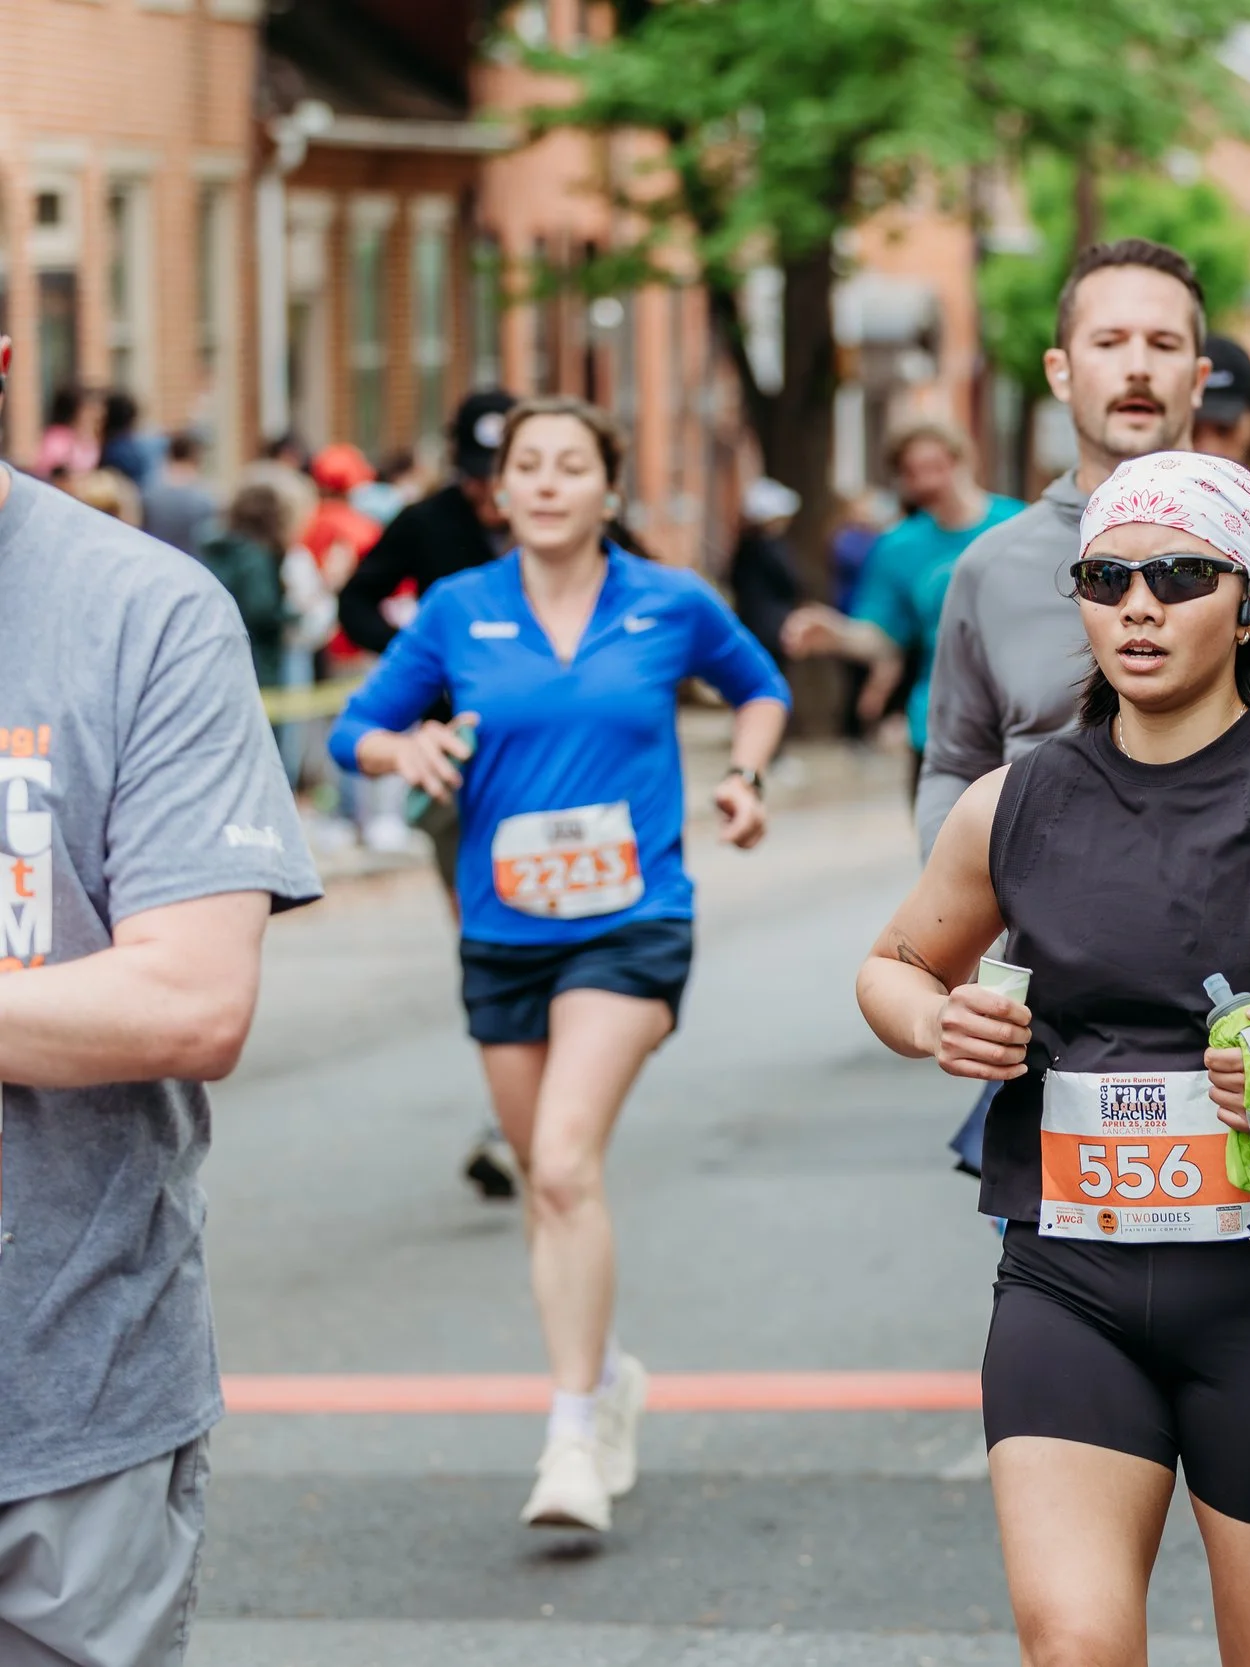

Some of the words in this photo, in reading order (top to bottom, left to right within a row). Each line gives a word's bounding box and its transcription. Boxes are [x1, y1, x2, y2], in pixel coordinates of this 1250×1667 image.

[1100, 1085, 1111, 1120] ywca
[1110, 1086, 1166, 1104] race
[1110, 1105, 1167, 1120] RACISM
[1102, 1120, 1126, 1128] APRIL
[1128, 1120, 1142, 1128] 25,
[1144, 1120, 1167, 1128] 2026
[1156, 1127, 1168, 1135] PA
[1078, 1143, 1203, 1199] 556
[1056, 1214, 1083, 1224] ywca
